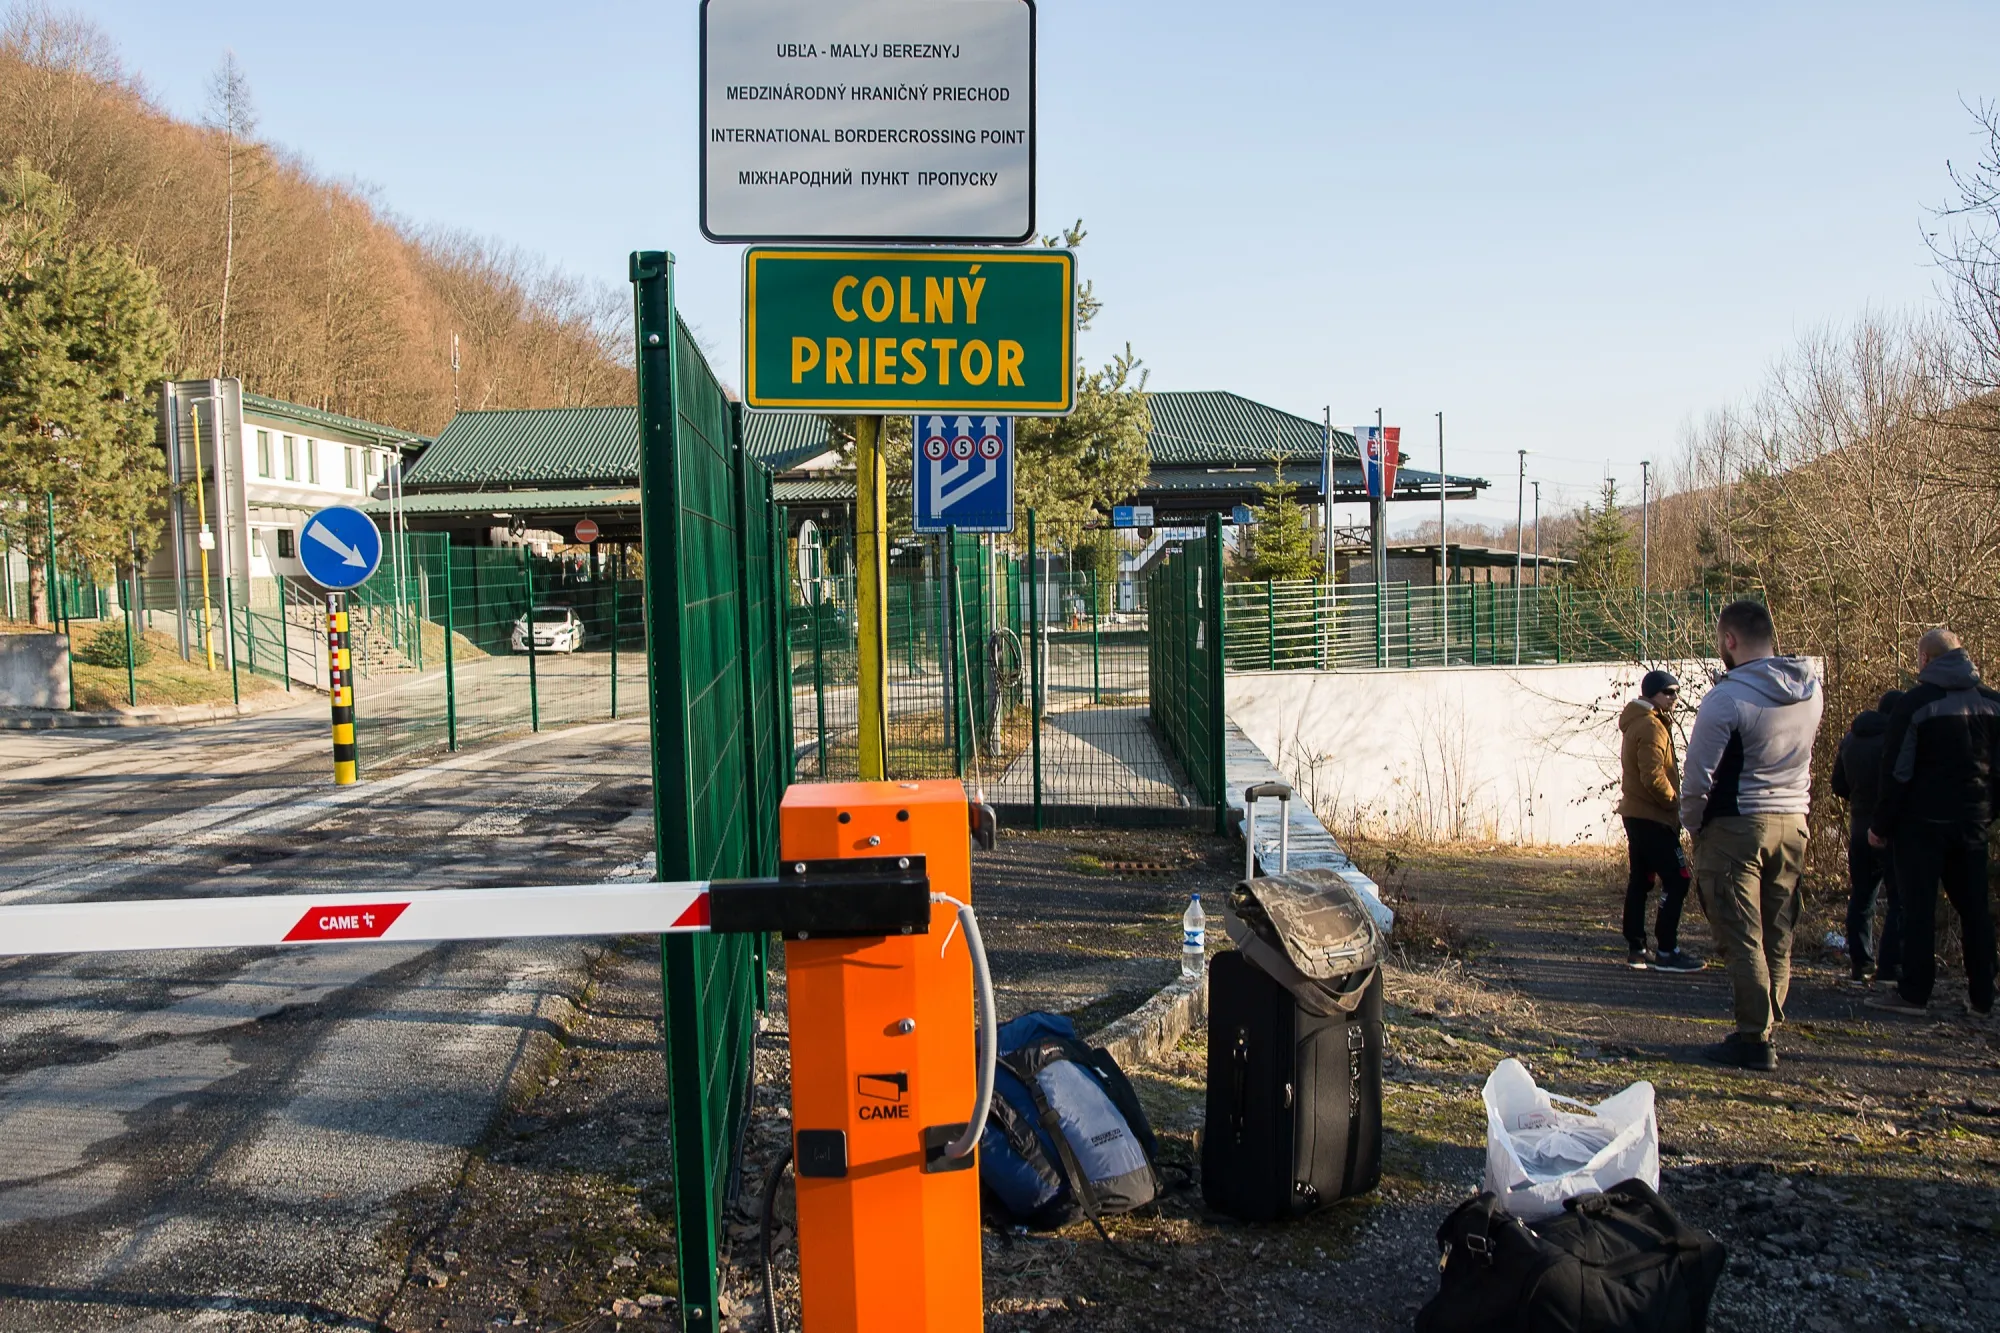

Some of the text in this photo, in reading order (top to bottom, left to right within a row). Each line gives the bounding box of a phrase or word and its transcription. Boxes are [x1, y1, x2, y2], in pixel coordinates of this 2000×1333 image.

[777, 43, 818, 58] UBĽA
[830, 43, 878, 58] MALYJ
[883, 44, 960, 58] BEREZNYJ
[726, 83, 1010, 101] MEDZINÁRODNÝ HRANIČNÝ PRIECHOD
[711, 128, 1026, 144] INTERNATIONAL BORDERCROSSING POINT
[738, 168, 998, 187] МІЖНАРОДНИЙ ПУНКТ ПРОПУСКУ
[832, 264, 986, 324] COLNÝ
[791, 336, 1026, 387] PRIESTOR
[932, 440, 995, 455] 5 5 5
[319, 915, 360, 930] CAME
[858, 1104, 909, 1120] CAME
